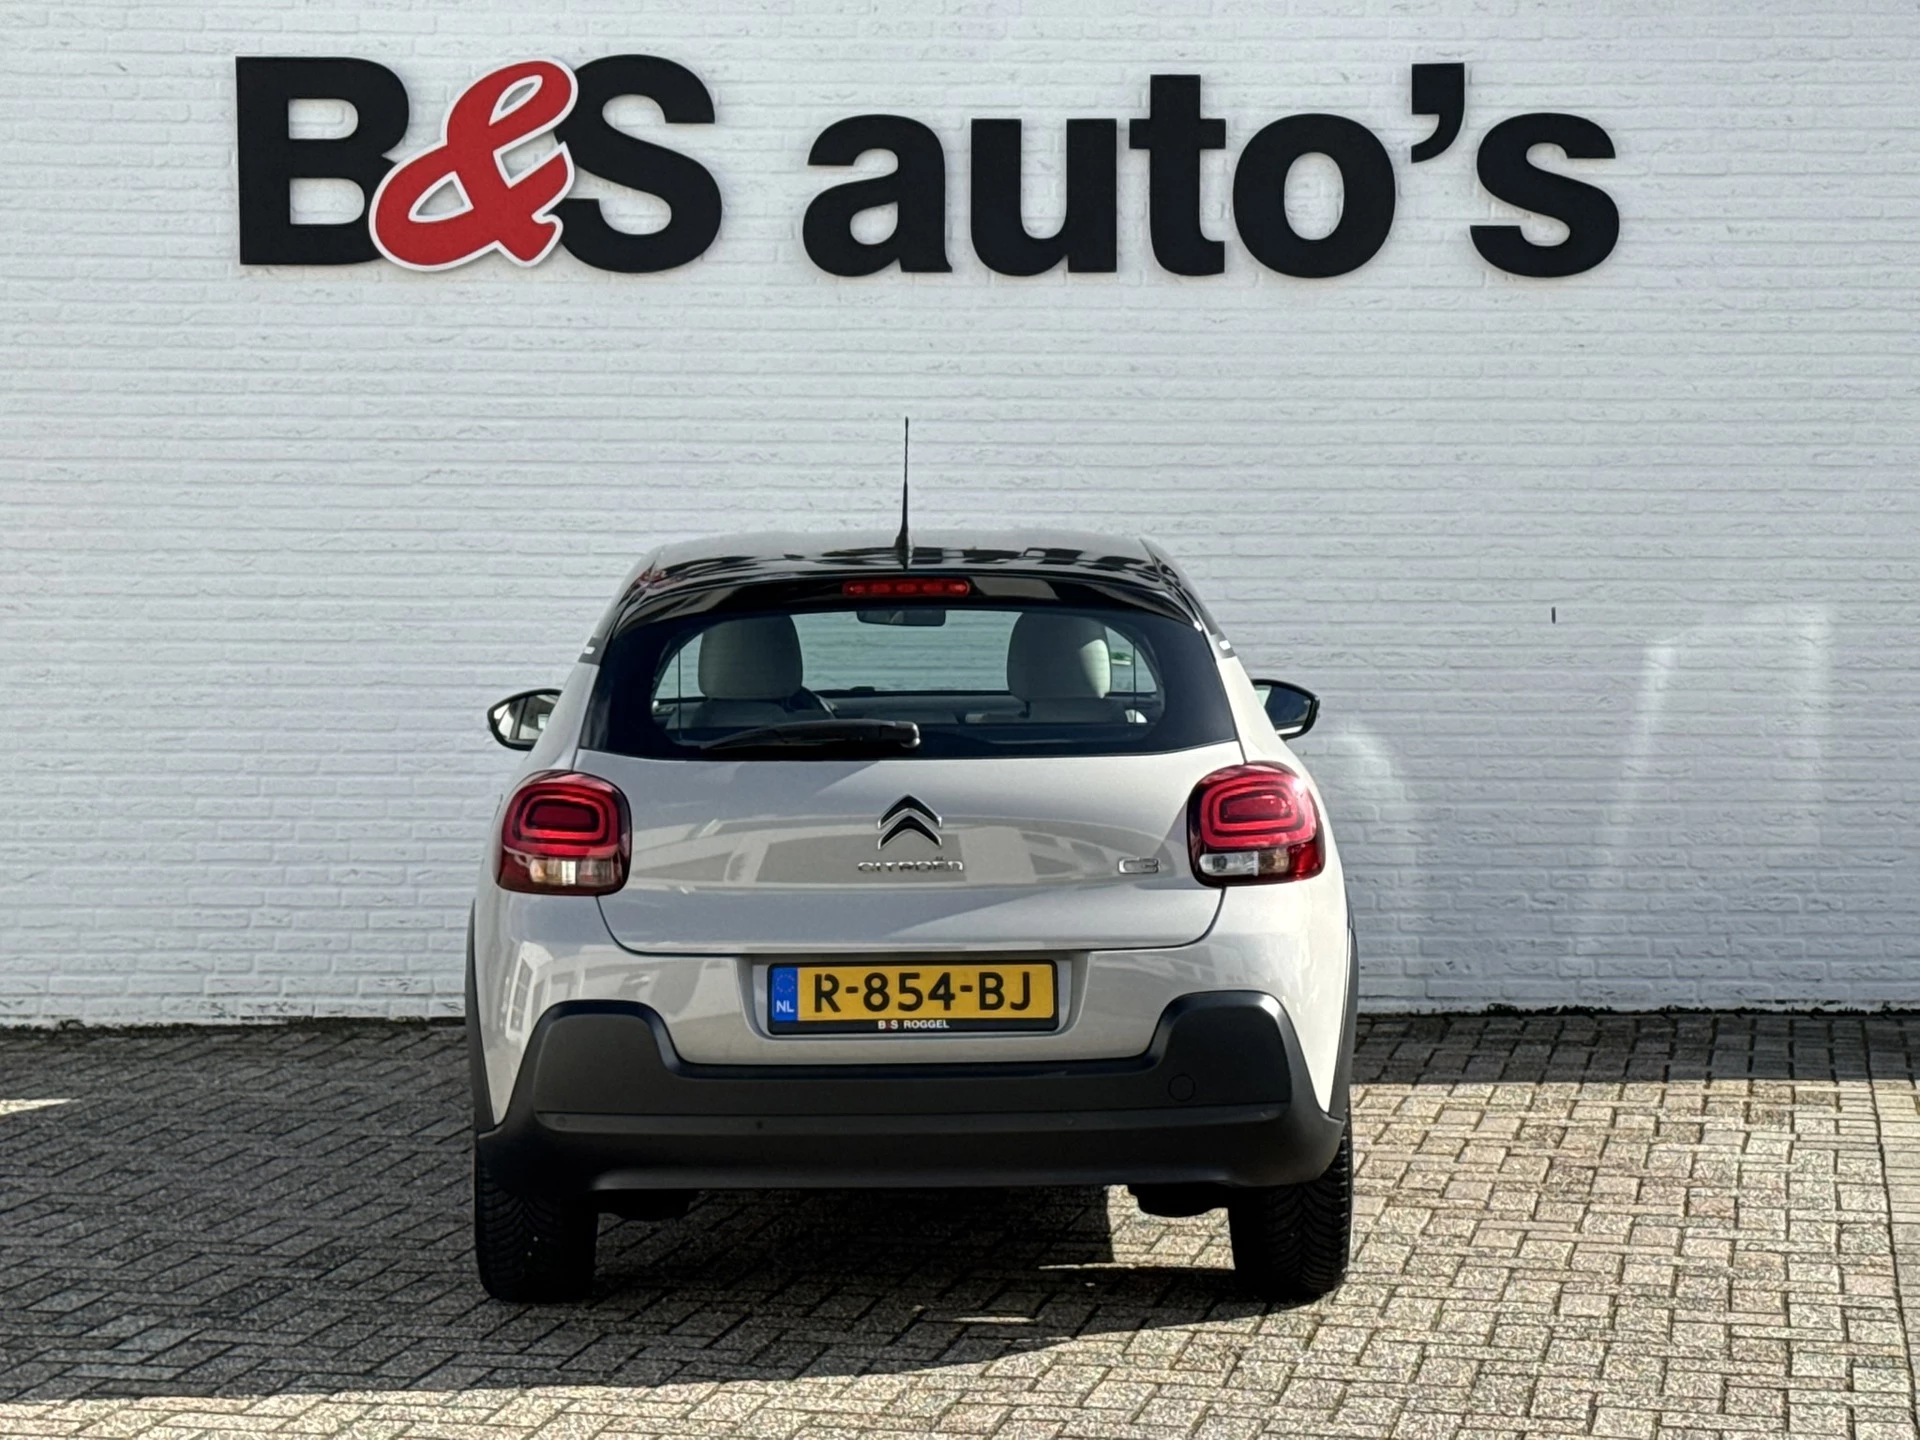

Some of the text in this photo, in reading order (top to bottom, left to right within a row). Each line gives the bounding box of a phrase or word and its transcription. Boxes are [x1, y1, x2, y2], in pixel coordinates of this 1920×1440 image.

[236, 55, 1619, 278] B&S auto's
[1118, 857, 1159, 875] C3
[814, 972, 1031, 1013] R-854-BJ
[775, 1000, 795, 1013] NL
[903, 1019, 950, 1029] ROGGEL
